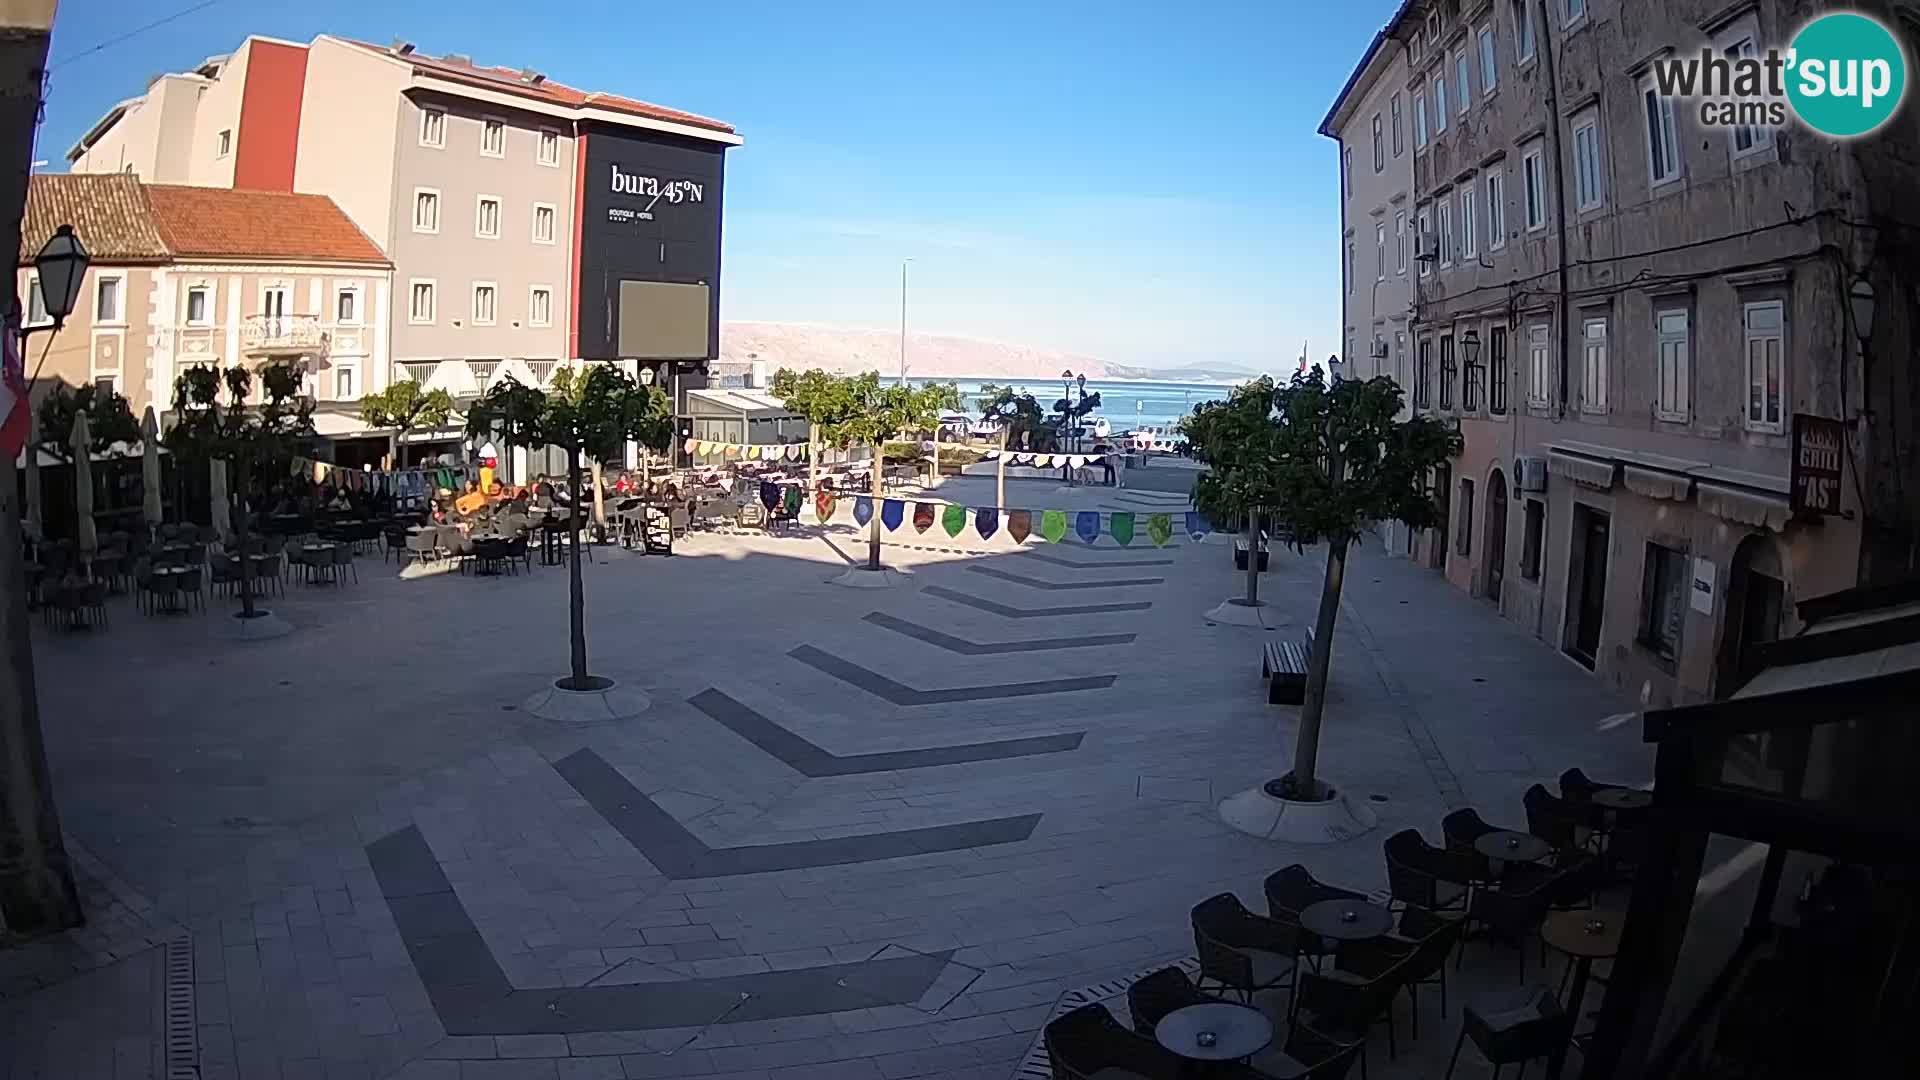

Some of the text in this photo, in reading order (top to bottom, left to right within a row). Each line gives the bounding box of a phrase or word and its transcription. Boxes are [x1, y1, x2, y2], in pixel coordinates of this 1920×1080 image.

[611, 165, 659, 196] bura
[608, 208, 654, 221] BOUTIQUE HOTEL
[1800, 447, 1840, 471] GRILL
